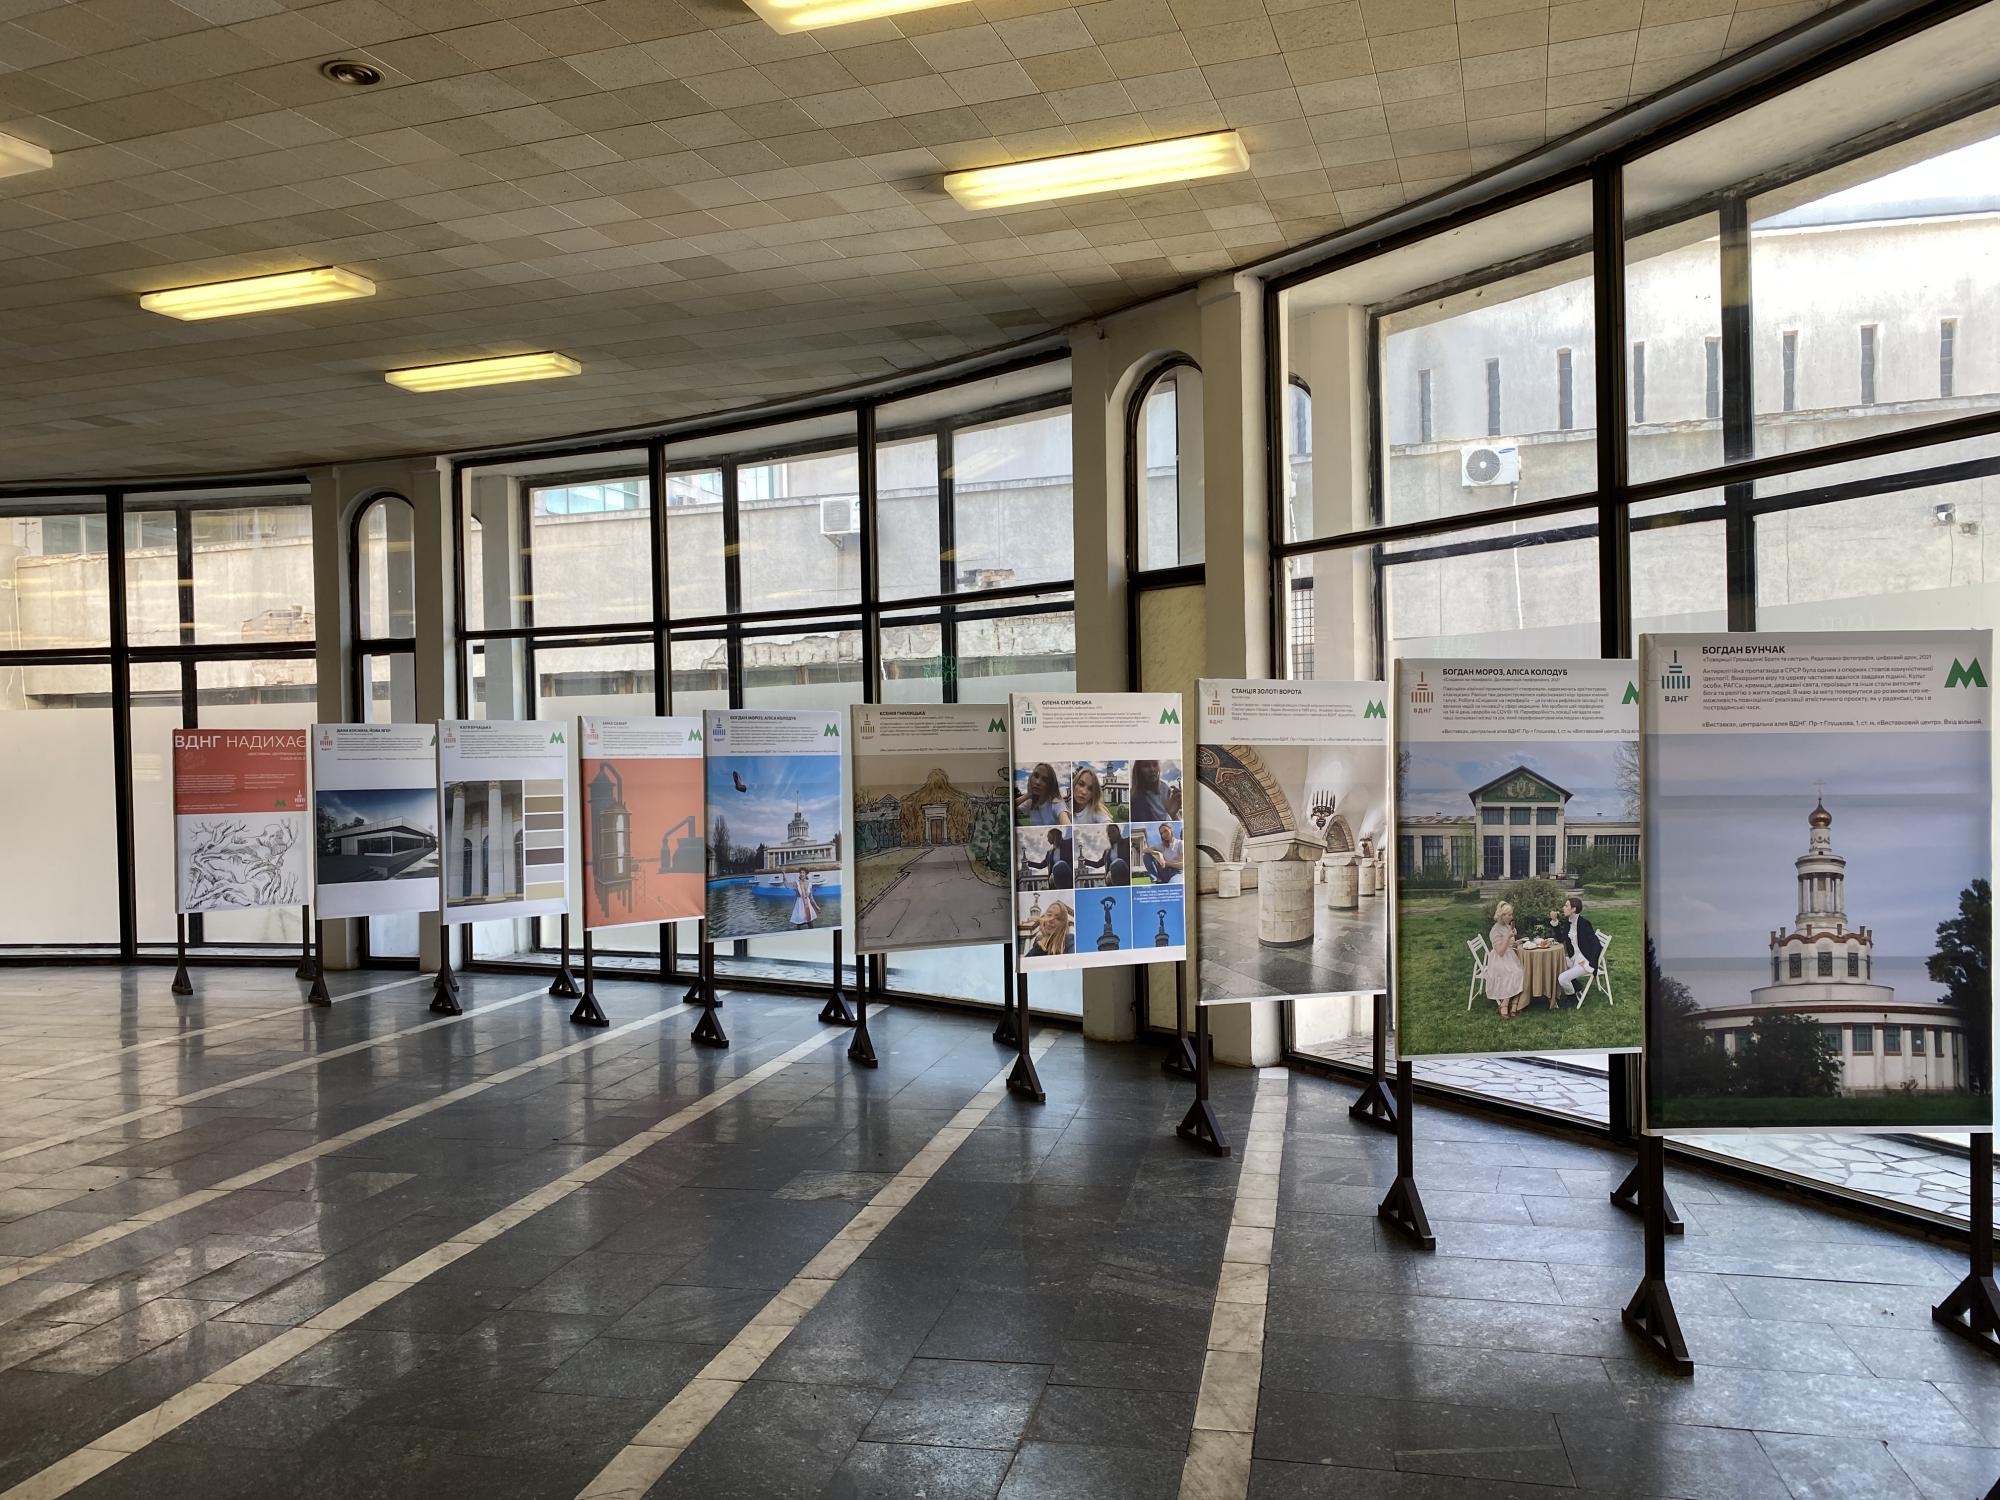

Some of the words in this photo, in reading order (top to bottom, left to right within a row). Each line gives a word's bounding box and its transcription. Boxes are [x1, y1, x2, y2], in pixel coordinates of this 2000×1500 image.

[1702, 646, 1743, 655] БОГДАН
[1745, 645, 1785, 654] БУНЧАК
[1475, 669, 1505, 677] МОРОЗ,
[1664, 695, 1689, 703] ВДНГ
[174, 735, 221, 750] ВДНГ
[226, 735, 306, 750] НАДИХАЄ
